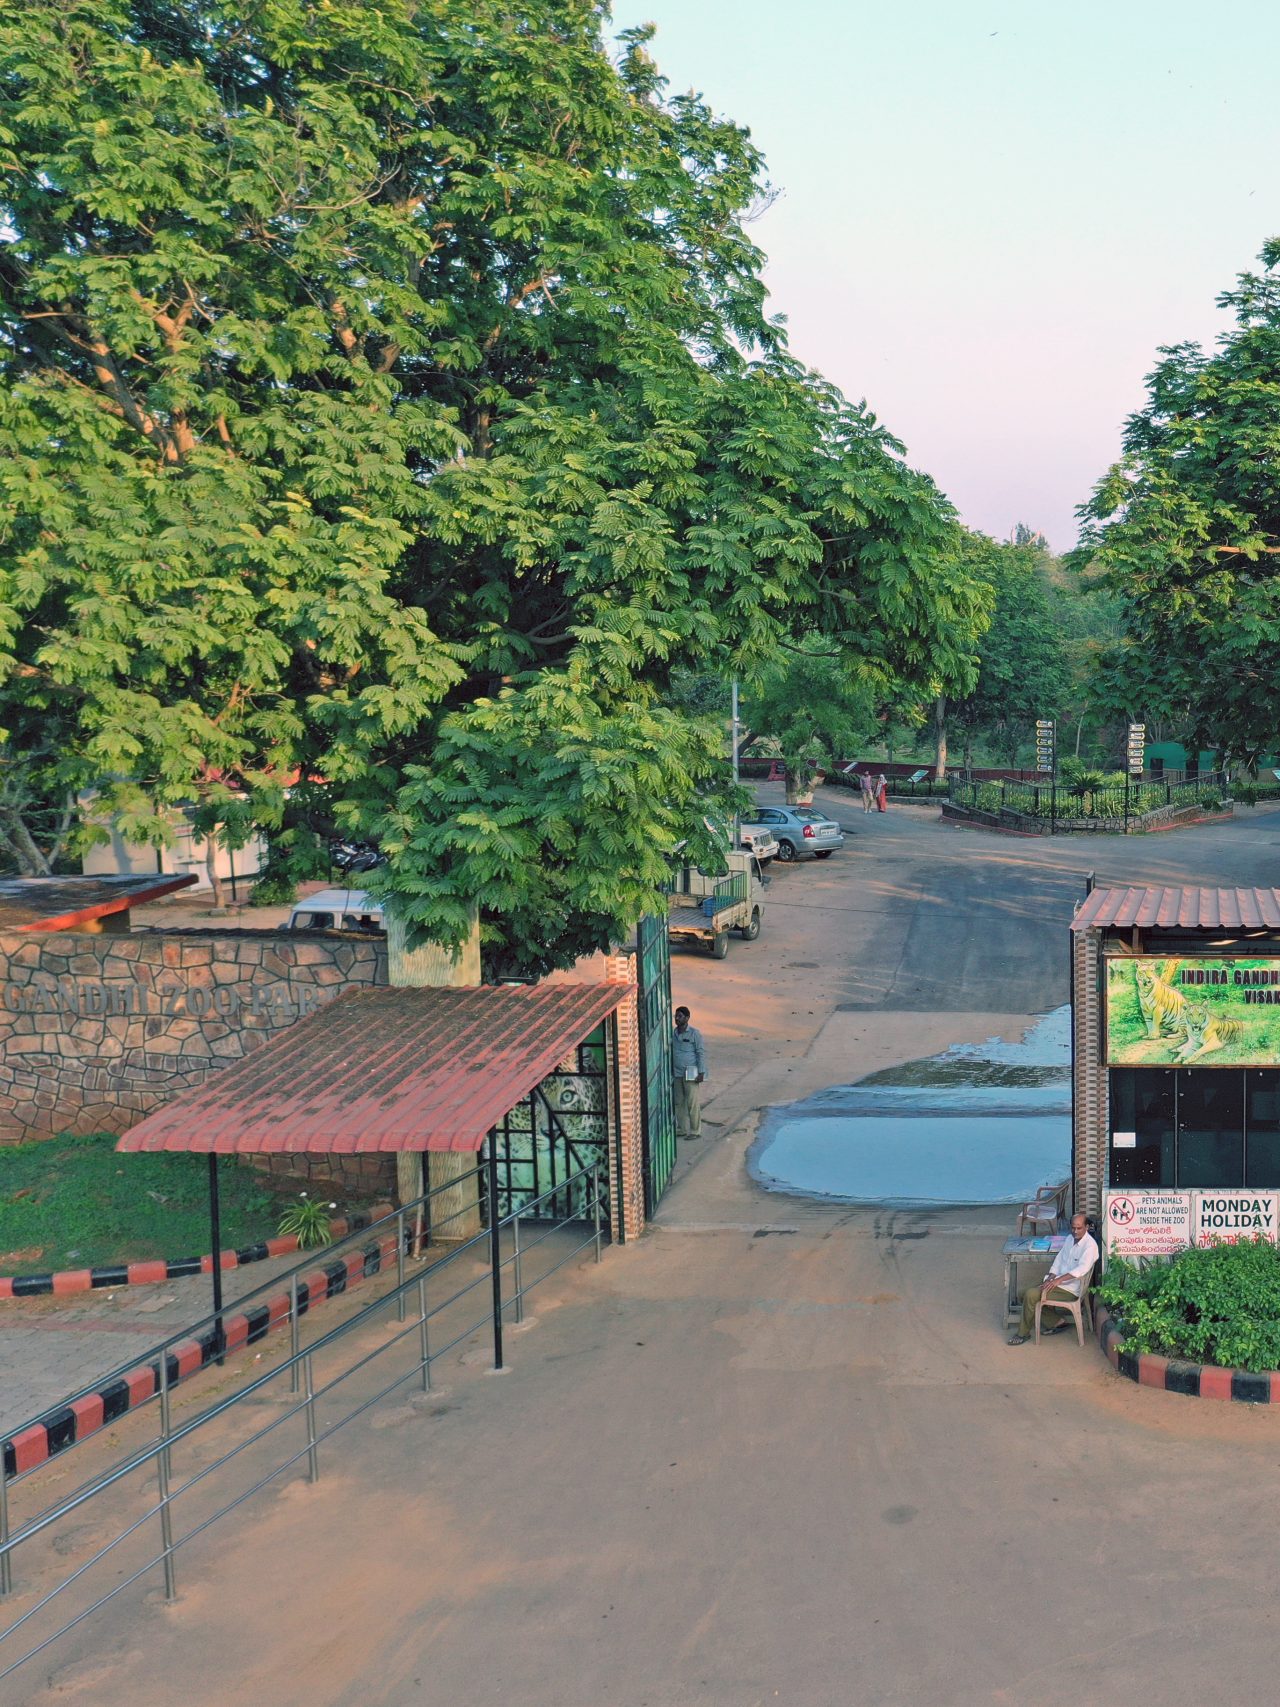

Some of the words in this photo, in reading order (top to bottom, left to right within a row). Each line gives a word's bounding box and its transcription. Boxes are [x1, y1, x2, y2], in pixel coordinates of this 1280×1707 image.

[1181, 968, 1228, 985] INDIRA
[3, 981, 152, 1015] GANDHI
[164, 983, 239, 1016] ZOO
[1142, 1197, 1156, 1205] PETS
[1157, 1197, 1183, 1205] ANIMALS
[1202, 1199, 1272, 1212] MONDAY
[1136, 1206, 1147, 1215] ARE
[1148, 1206, 1161, 1215] NOT
[1162, 1206, 1189, 1215] ALLOWED
[1140, 1217, 1159, 1225] INSIDE
[1161, 1217, 1172, 1225] THE
[1173, 1217, 1186, 1225] ZOO
[1201, 1215, 1273, 1227] HOLIDAY
